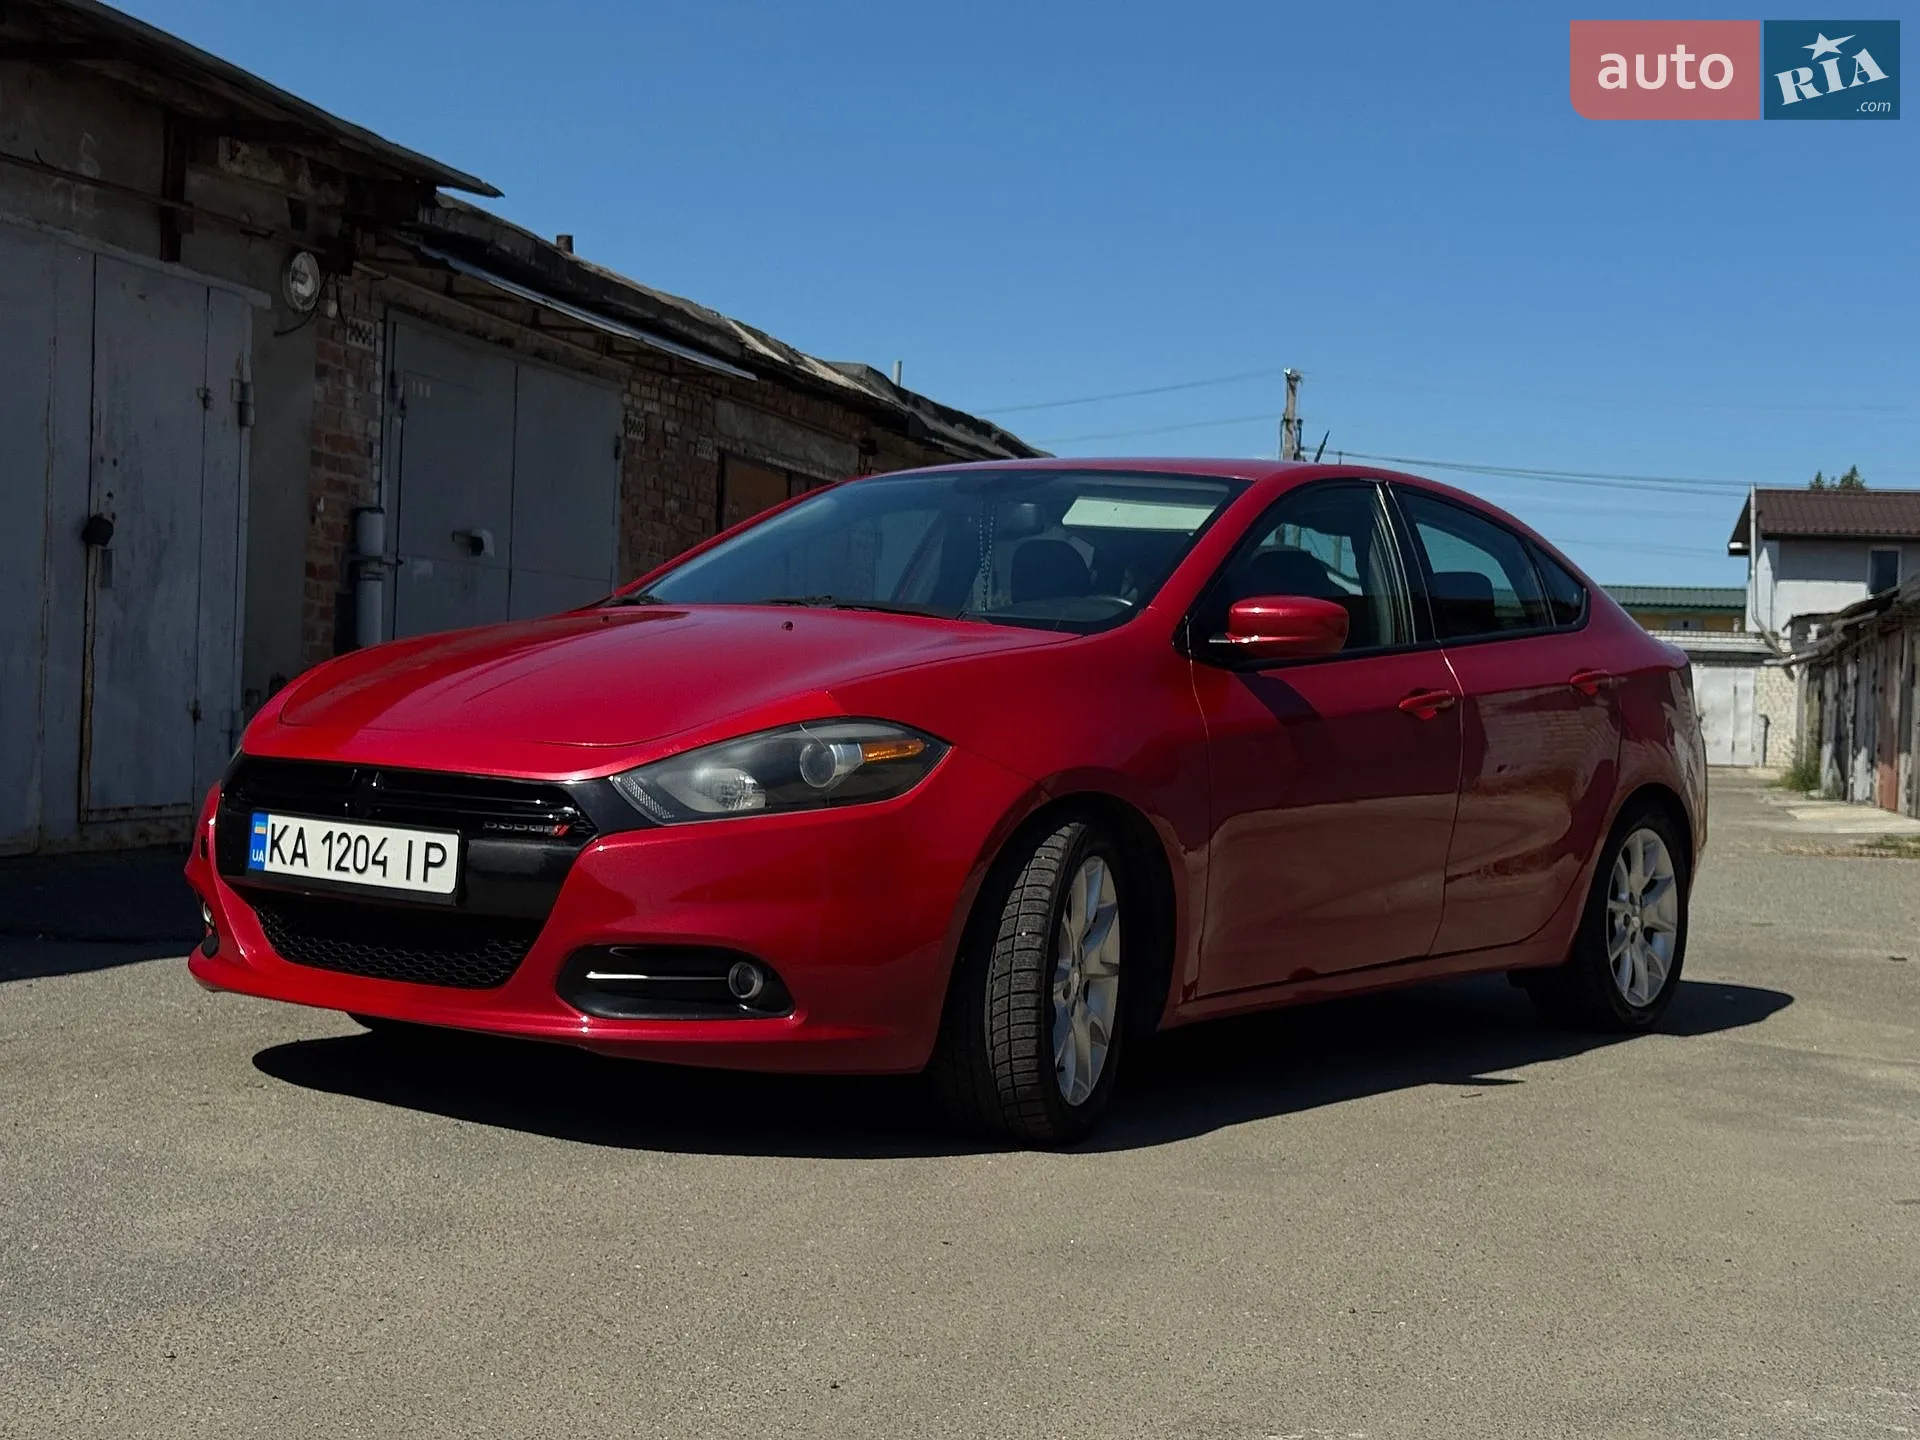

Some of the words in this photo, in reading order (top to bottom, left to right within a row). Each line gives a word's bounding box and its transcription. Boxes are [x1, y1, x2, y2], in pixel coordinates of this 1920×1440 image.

[252, 849, 265, 863] UA
[268, 823, 309, 868] KA
[321, 830, 389, 878] 1204
[405, 839, 448, 883] IP
